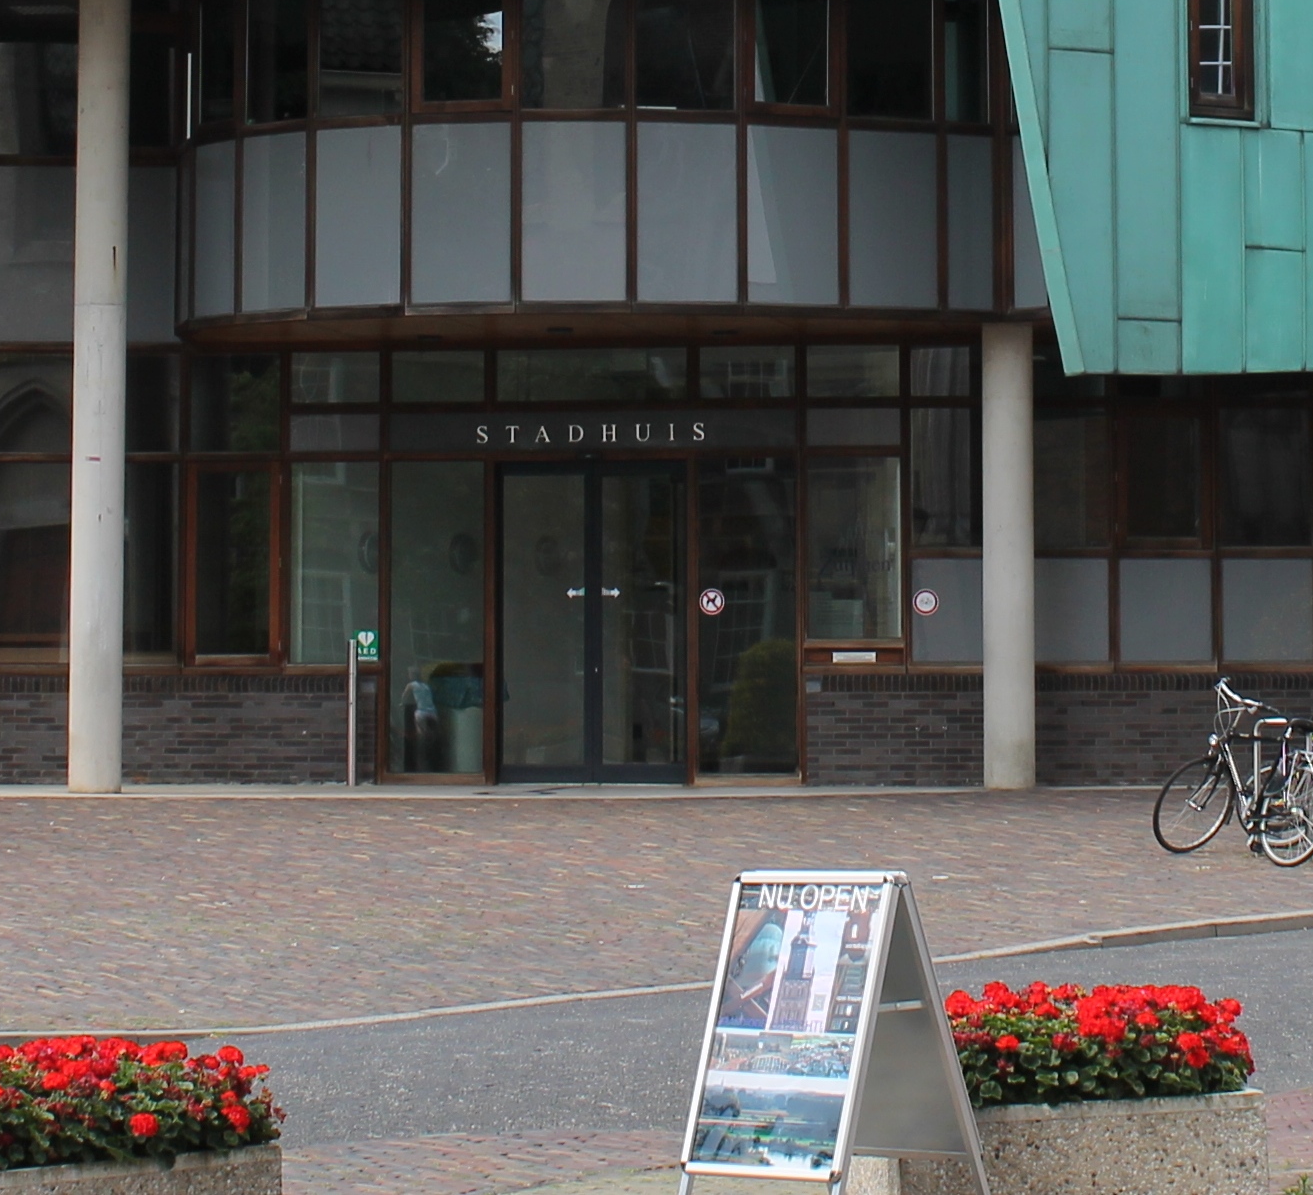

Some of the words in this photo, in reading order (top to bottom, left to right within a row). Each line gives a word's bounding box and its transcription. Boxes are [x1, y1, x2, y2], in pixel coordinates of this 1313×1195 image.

[476, 422, 706, 444] STADHUIS
[758, 884, 794, 909] NU
[800, 884, 869, 913] OPEN
